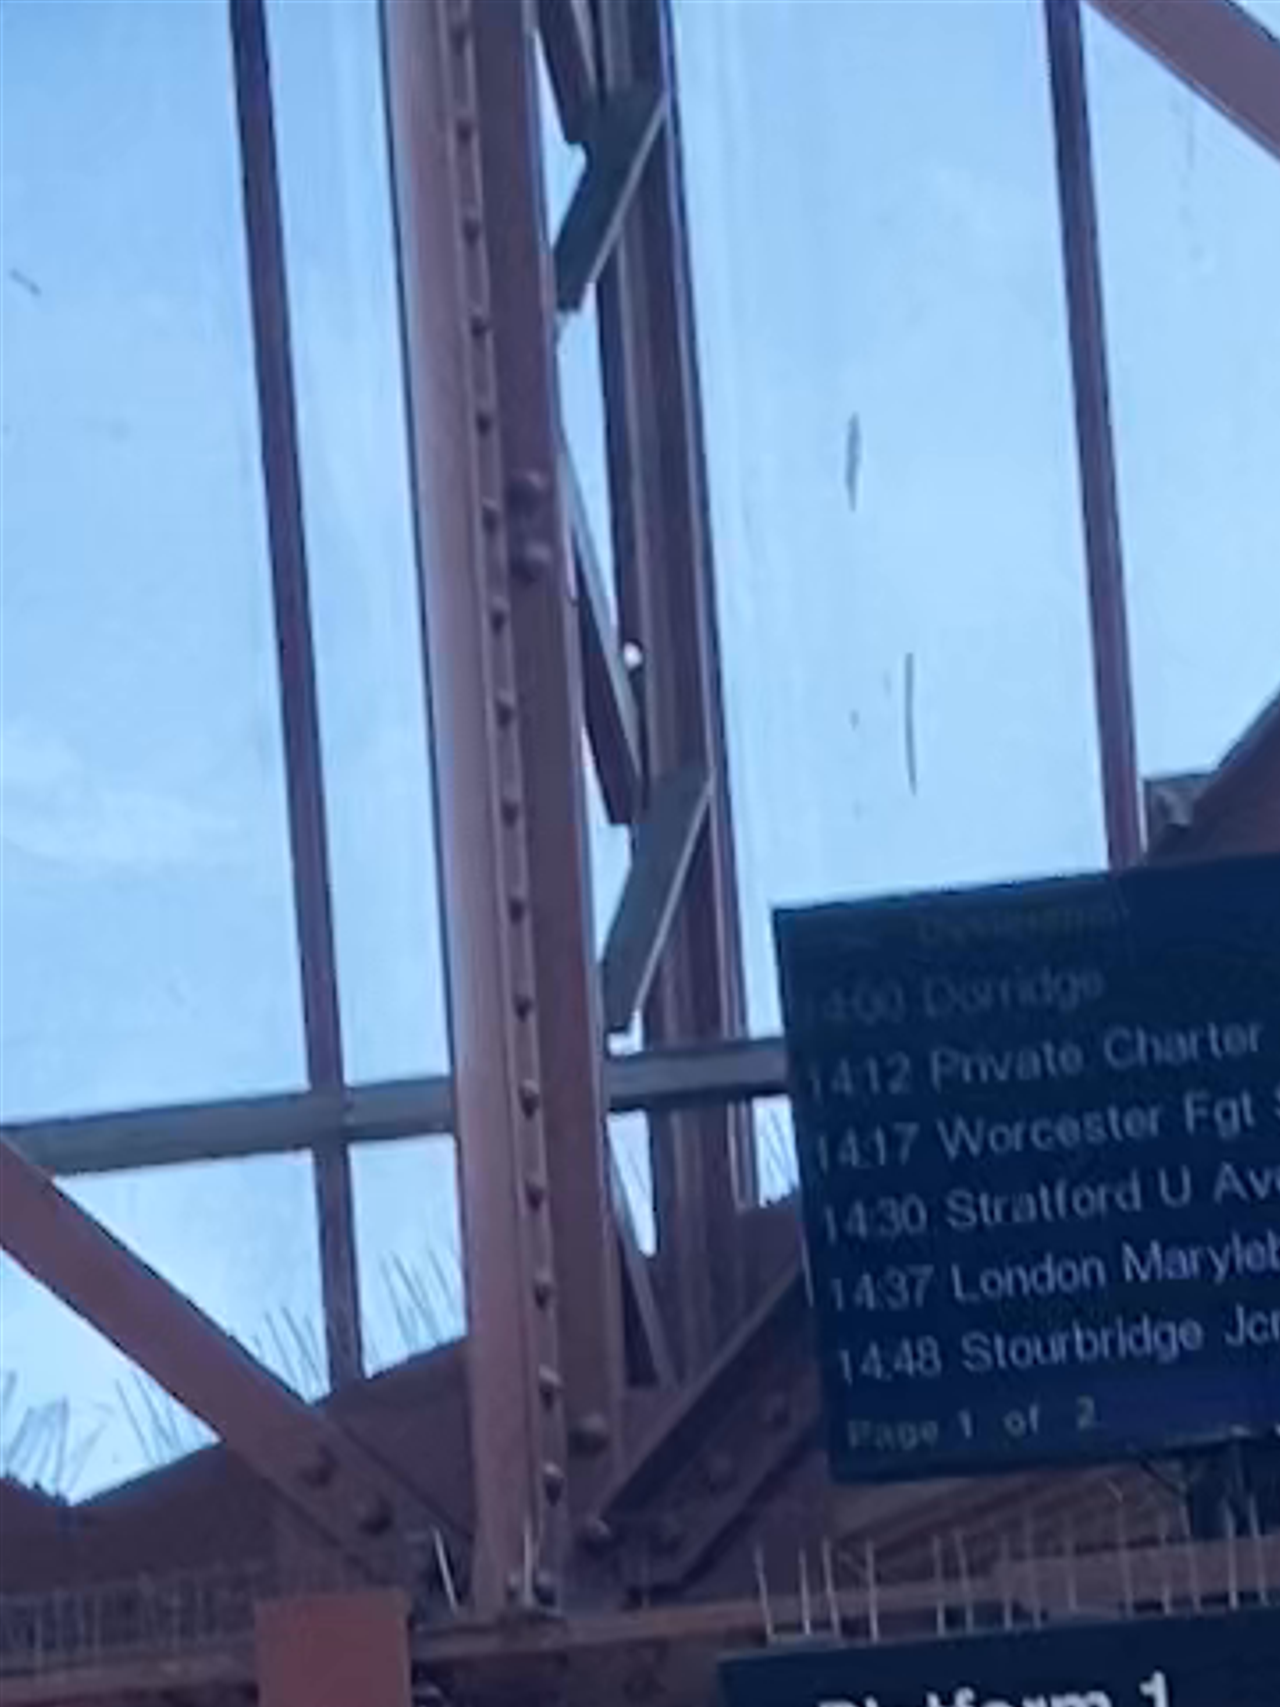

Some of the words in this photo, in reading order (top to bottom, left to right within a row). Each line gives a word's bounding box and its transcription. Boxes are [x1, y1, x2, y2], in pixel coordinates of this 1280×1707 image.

[929, 1040, 1084, 1093] Private
[1102, 1021, 1265, 1072] Charter
[935, 1099, 1163, 1163] Worcester
[1182, 1085, 1257, 1142] Fgt
[945, 1166, 1141, 1232] Stratford
[1157, 1163, 1191, 1208] U
[950, 1253, 1107, 1305] London
[961, 1313, 1204, 1374] Stourbridge
[848, 1418, 940, 1451] Page
[958, 1408, 978, 1440] 1
[1002, 1401, 1043, 1438] of
[1076, 1394, 1099, 1431] 2
